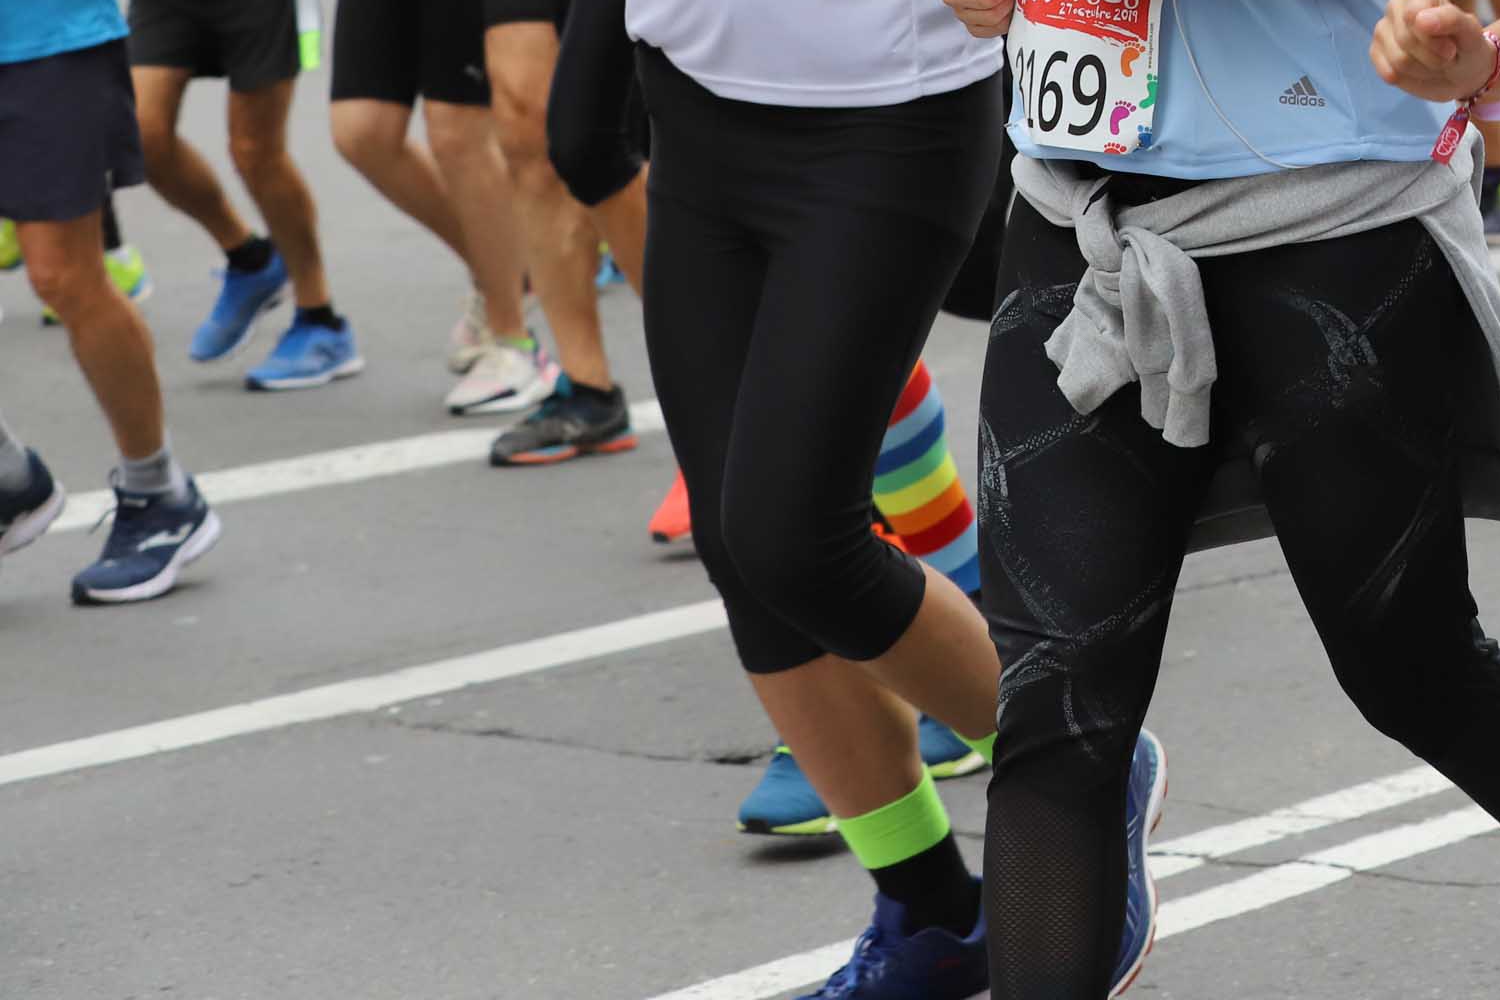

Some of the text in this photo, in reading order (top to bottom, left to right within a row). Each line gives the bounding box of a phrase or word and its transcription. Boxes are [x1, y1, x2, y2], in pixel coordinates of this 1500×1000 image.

[1059, 2, 1072, 16] 27
[1113, 8, 1138, 23] 2019
[1279, 95, 1325, 107] adidas
